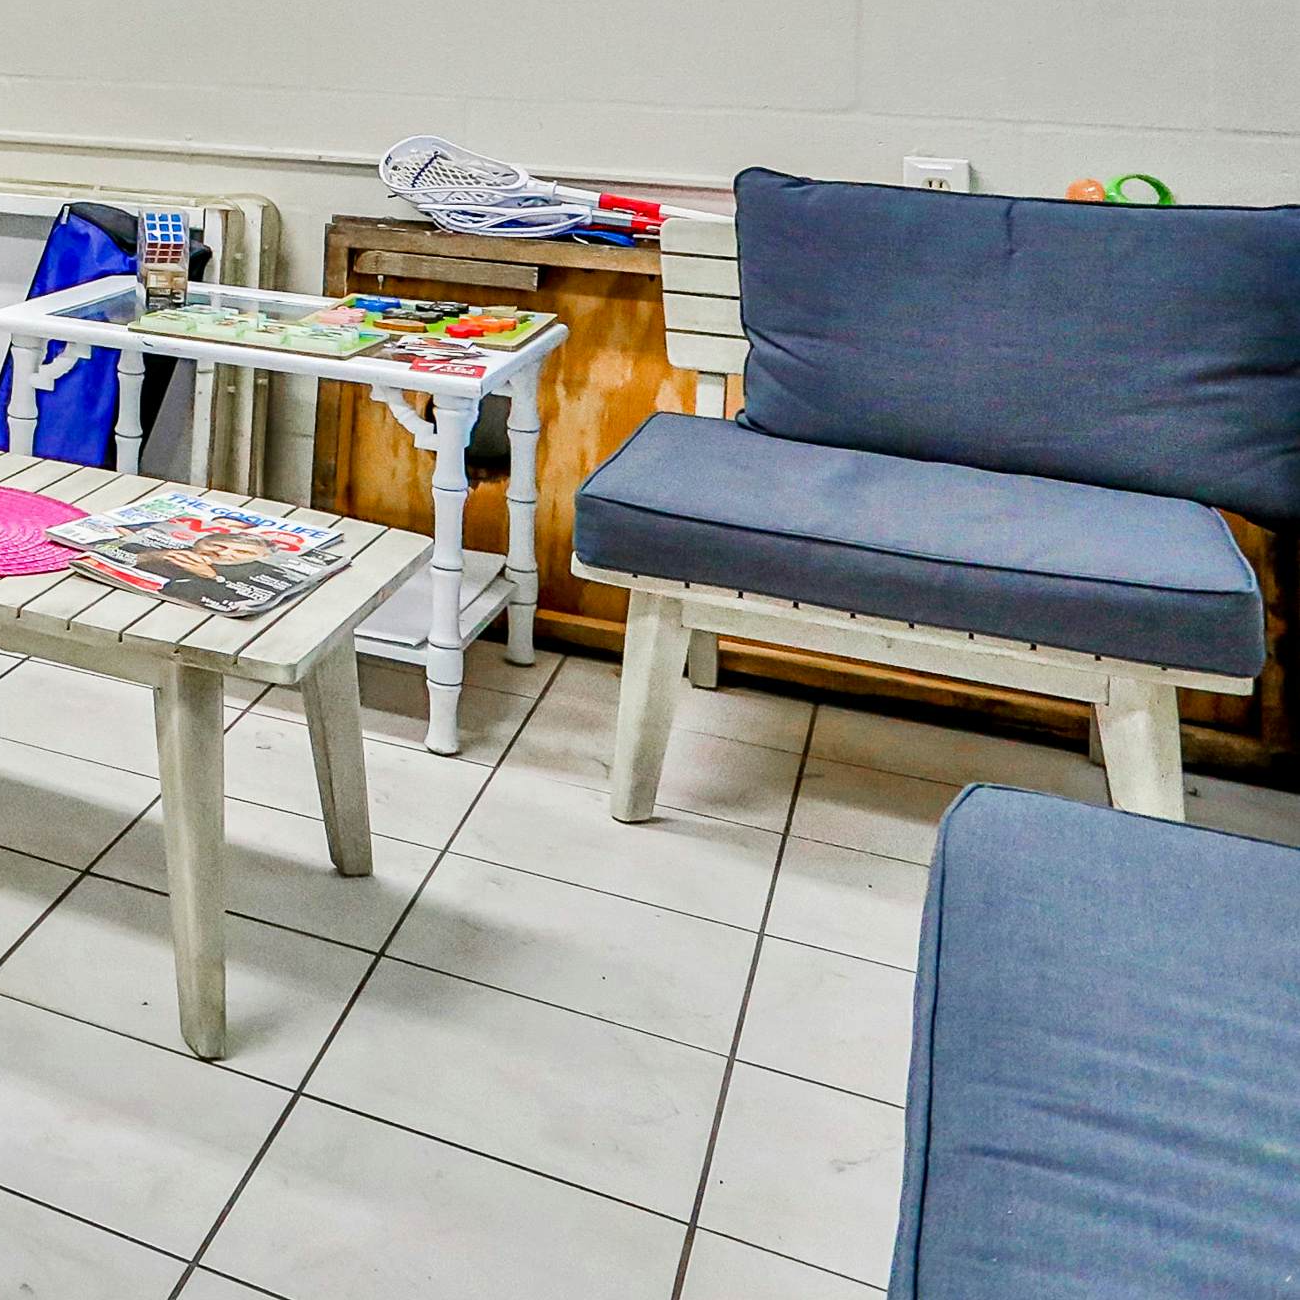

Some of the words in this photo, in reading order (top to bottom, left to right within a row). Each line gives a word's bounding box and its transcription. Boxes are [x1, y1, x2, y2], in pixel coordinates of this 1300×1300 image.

[167, 493, 206, 512] THE
[208, 506, 277, 528] GOOD
[277, 522, 332, 540] LIFE
